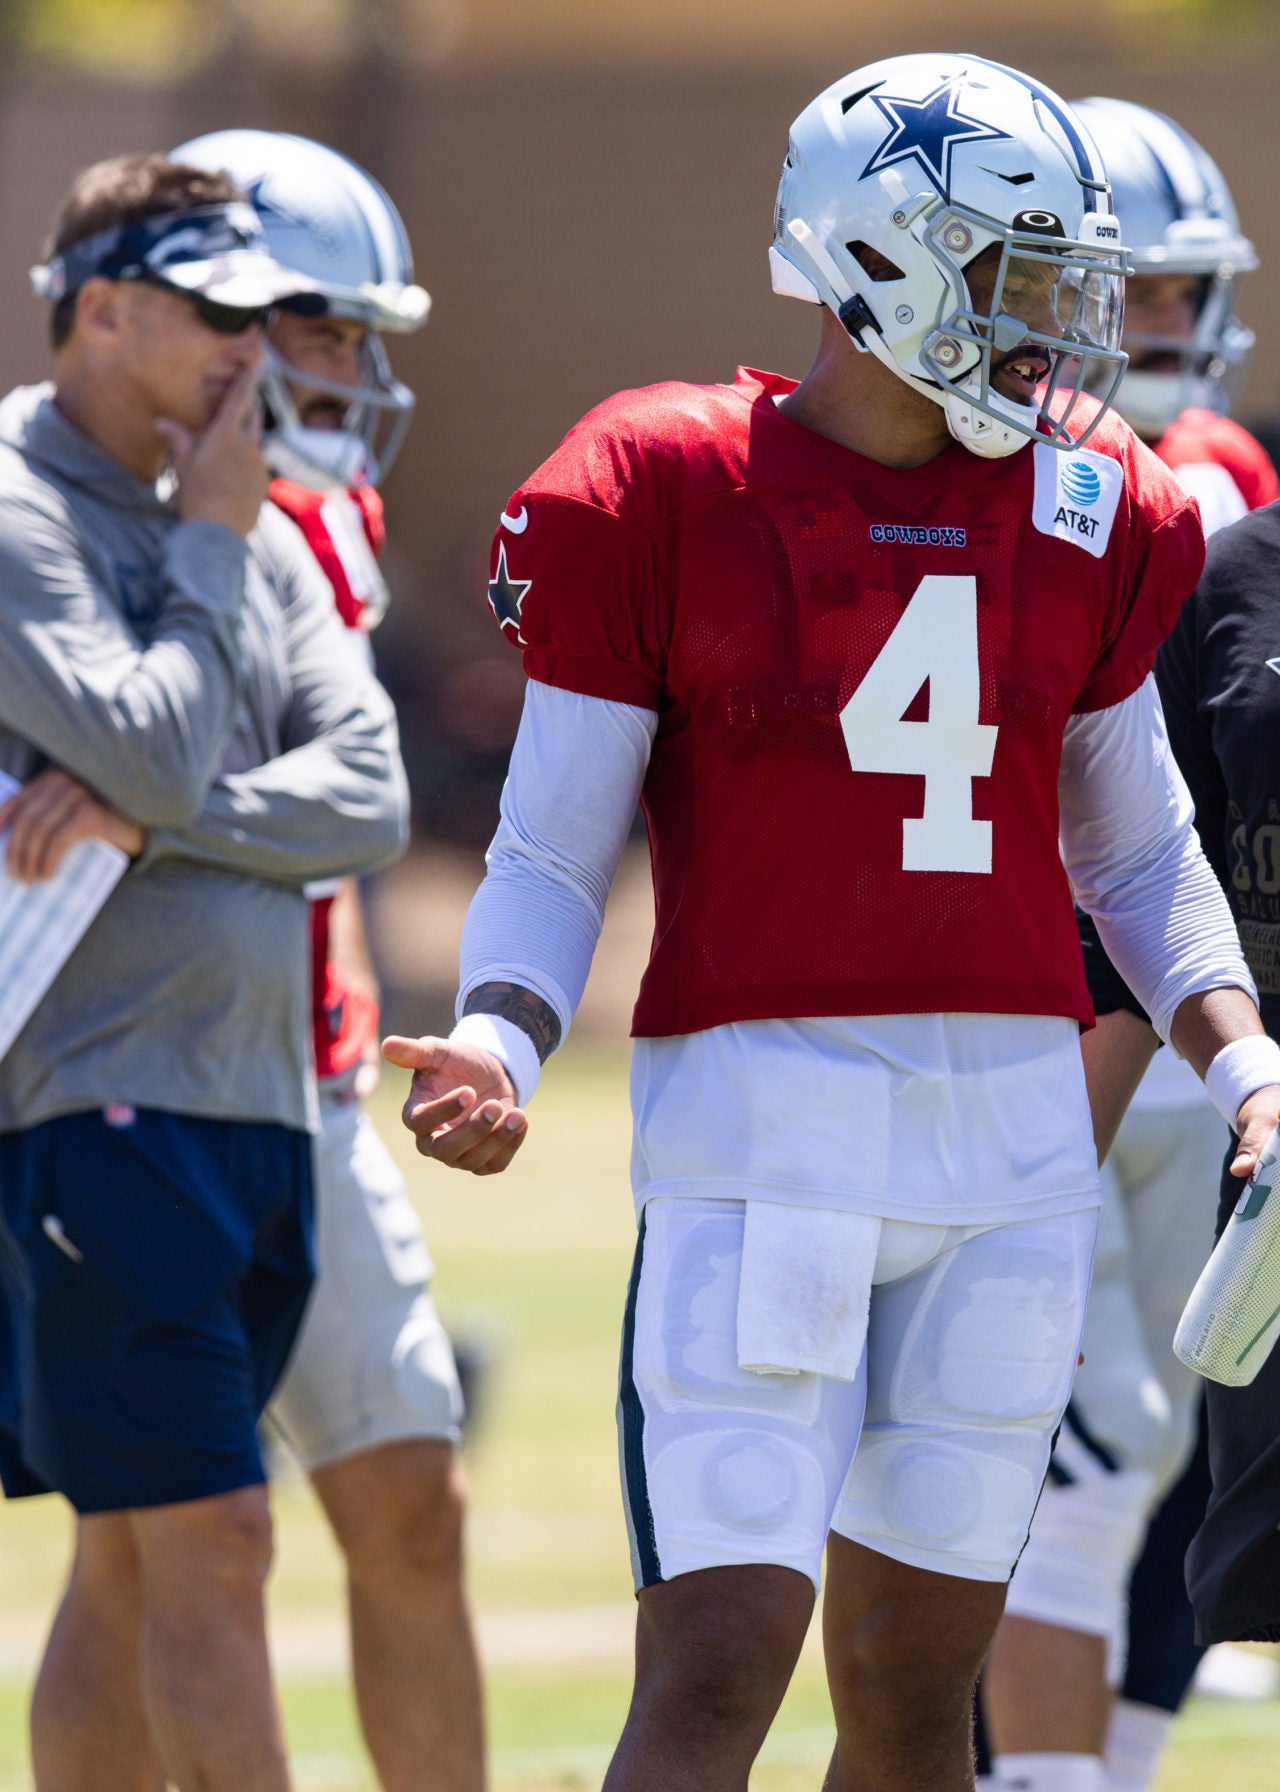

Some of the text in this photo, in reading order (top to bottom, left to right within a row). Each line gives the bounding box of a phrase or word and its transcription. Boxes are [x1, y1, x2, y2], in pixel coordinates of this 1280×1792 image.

[870, 524, 966, 547] COWBOYS
[1053, 506, 1100, 539] AT&T
[839, 575, 999, 874] 4
